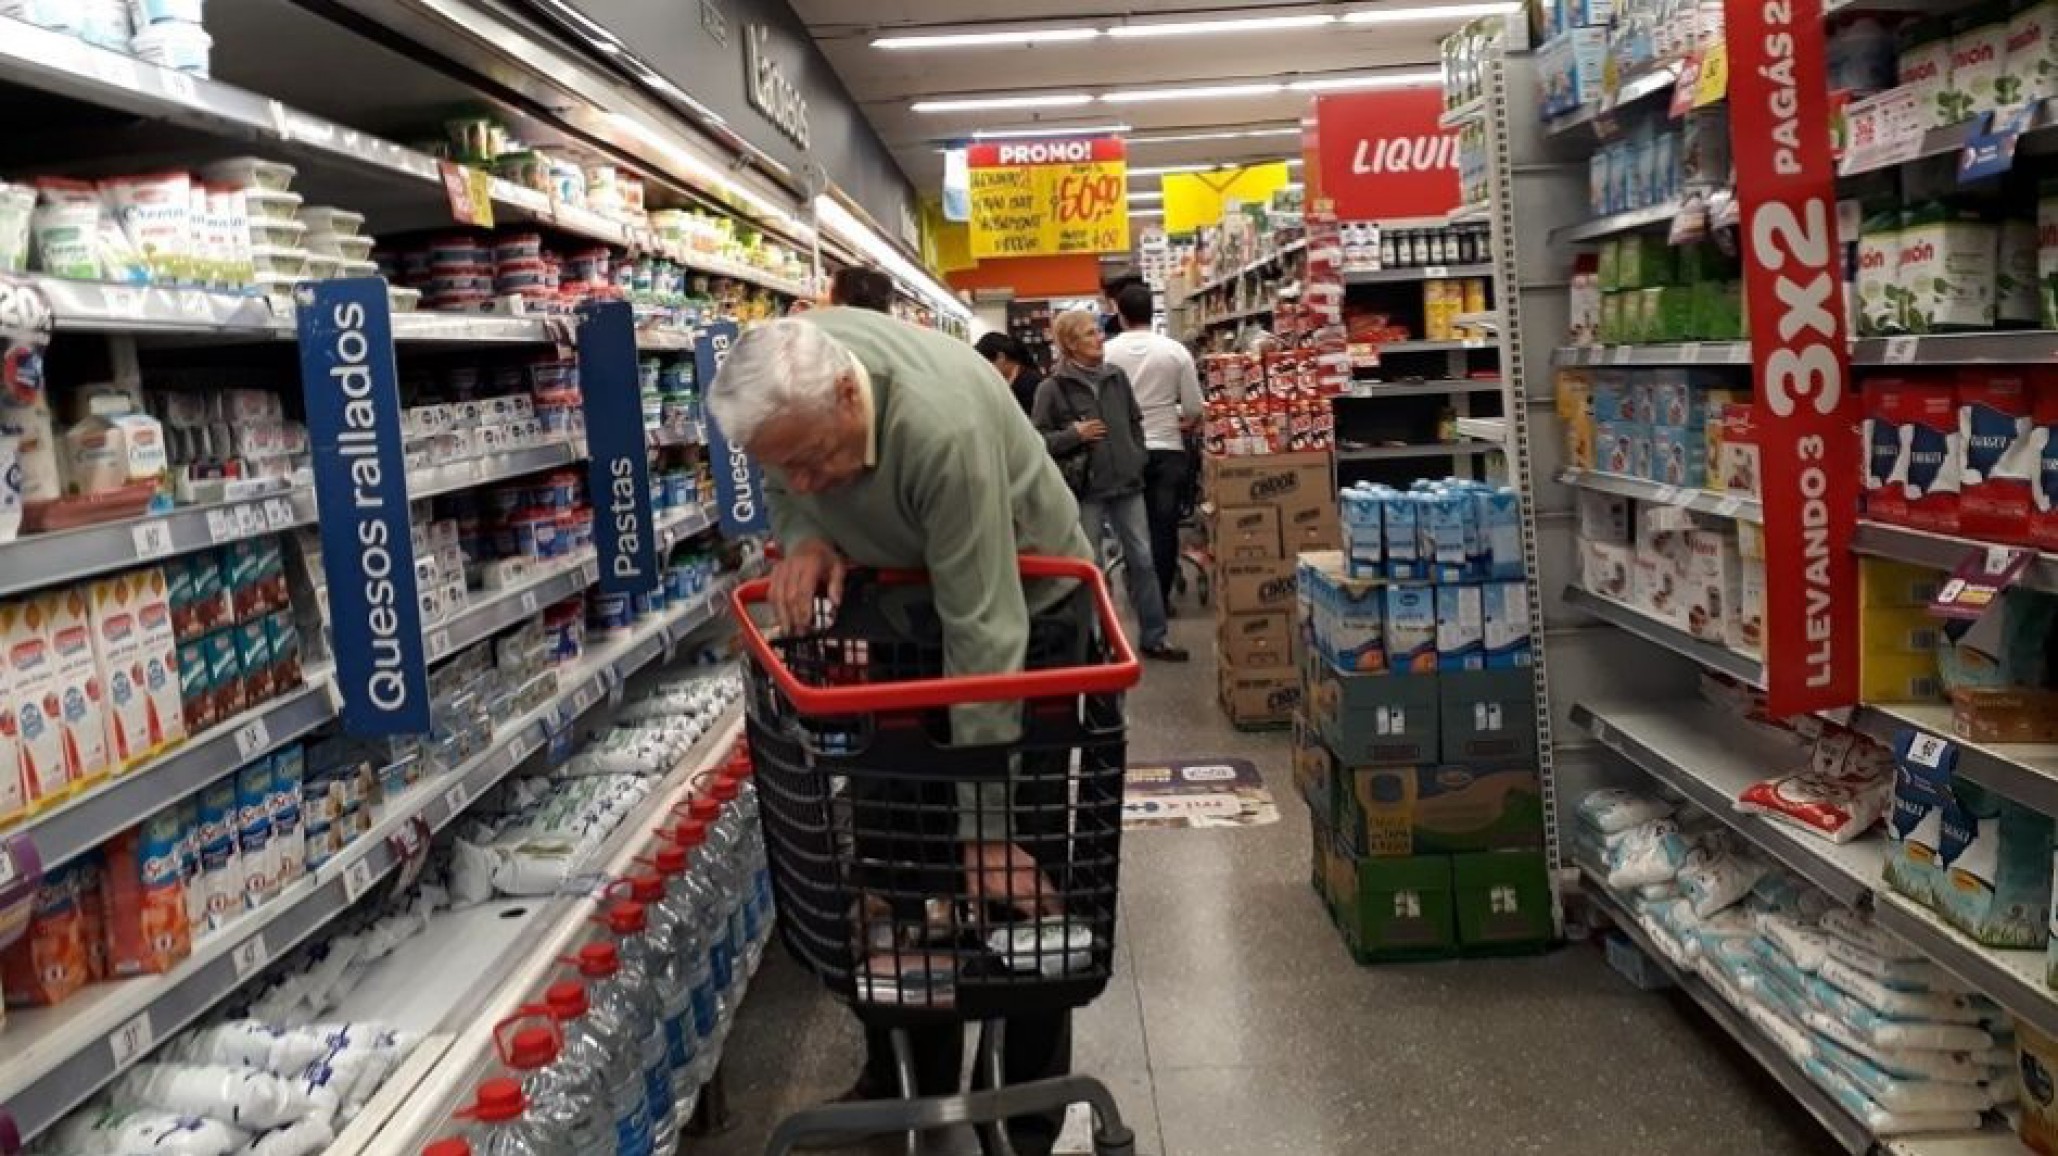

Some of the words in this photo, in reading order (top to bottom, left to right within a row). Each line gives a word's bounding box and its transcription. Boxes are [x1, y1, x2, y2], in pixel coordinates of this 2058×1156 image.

[1763, 1, 1791, 25] 2
[1000, 140, 1093, 164] PROMO!
[1758, 32, 1802, 174] PAGÁS
[1752, 197, 1841, 417] 3x2
[330, 302, 383, 507] rallados
[1797, 434, 1824, 460] 3
[610, 458, 641, 577] Pastas
[1800, 467, 1831, 687] LLEVANDO
[358, 519, 405, 712] Quesos
